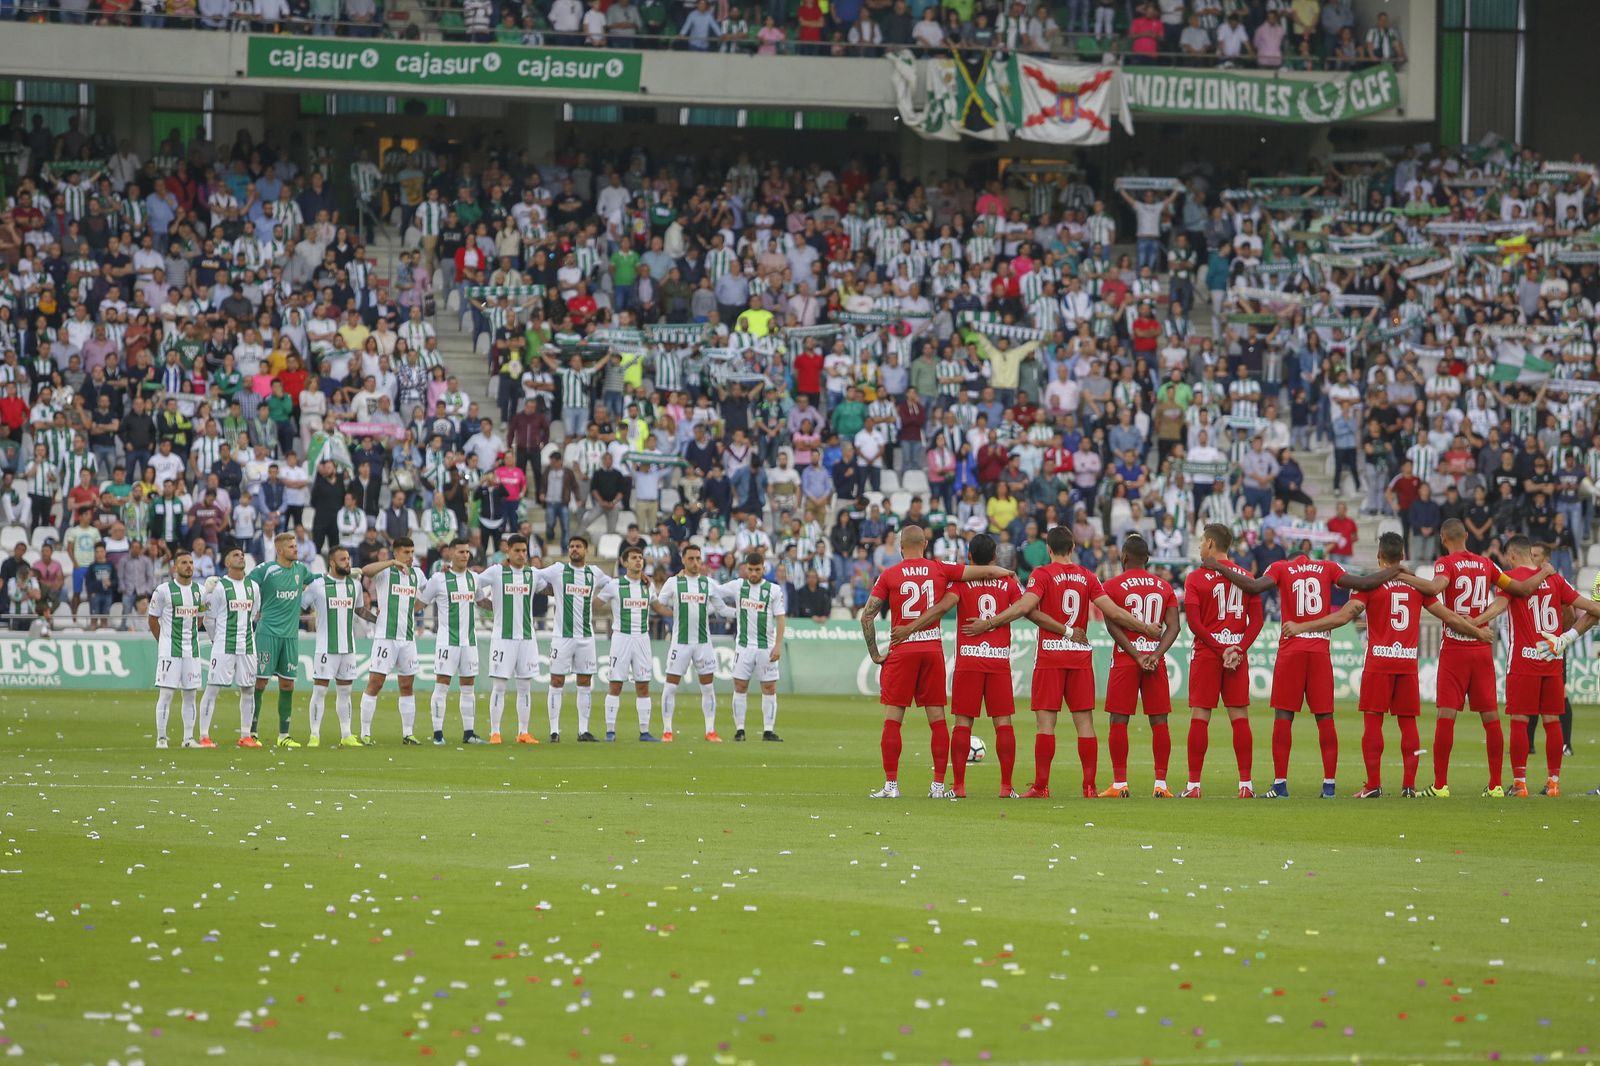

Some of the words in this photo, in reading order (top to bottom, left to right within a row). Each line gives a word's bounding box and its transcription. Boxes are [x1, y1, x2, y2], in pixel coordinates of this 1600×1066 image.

[268, 46, 359, 72] cajasur
[395, 52, 481, 79] cajasur
[517, 55, 604, 81] cajasur
[1350, 70, 1392, 110] CCF
[902, 566, 929, 577] NANO
[1287, 565, 1298, 575] S.
[1204, 572, 1215, 581] R.
[505, 585, 529, 595] tango
[566, 585, 590, 595] tango
[1120, 577, 1154, 591] PERVIS
[1157, 579, 1164, 590] E.
[393, 586, 414, 596] tango
[1292, 576, 1323, 617] 18
[1454, 575, 1487, 615] 24
[623, 599, 648, 609] tango
[681, 594, 706, 604] tango
[741, 598, 766, 610] tango
[900, 579, 935, 620] 21
[1212, 582, 1244, 621] 14
[978, 593, 997, 632] 8
[1062, 588, 1080, 628] 9
[1124, 592, 1164, 627] 30
[1390, 592, 1410, 632] 5
[1527, 593, 1559, 634] 16
[1043, 640, 1063, 649] COSTA
[377, 646, 388, 659] 16
[438, 649, 449, 660] 14
[492, 650, 504, 662] 21
[670, 649, 678, 660] 5
[960, 646, 980, 656] COSTA
[1373, 646, 1393, 656] COSTA
[211, 658, 217, 669] 9
[321, 653, 328, 664] 6
[161, 660, 172, 672] 17
